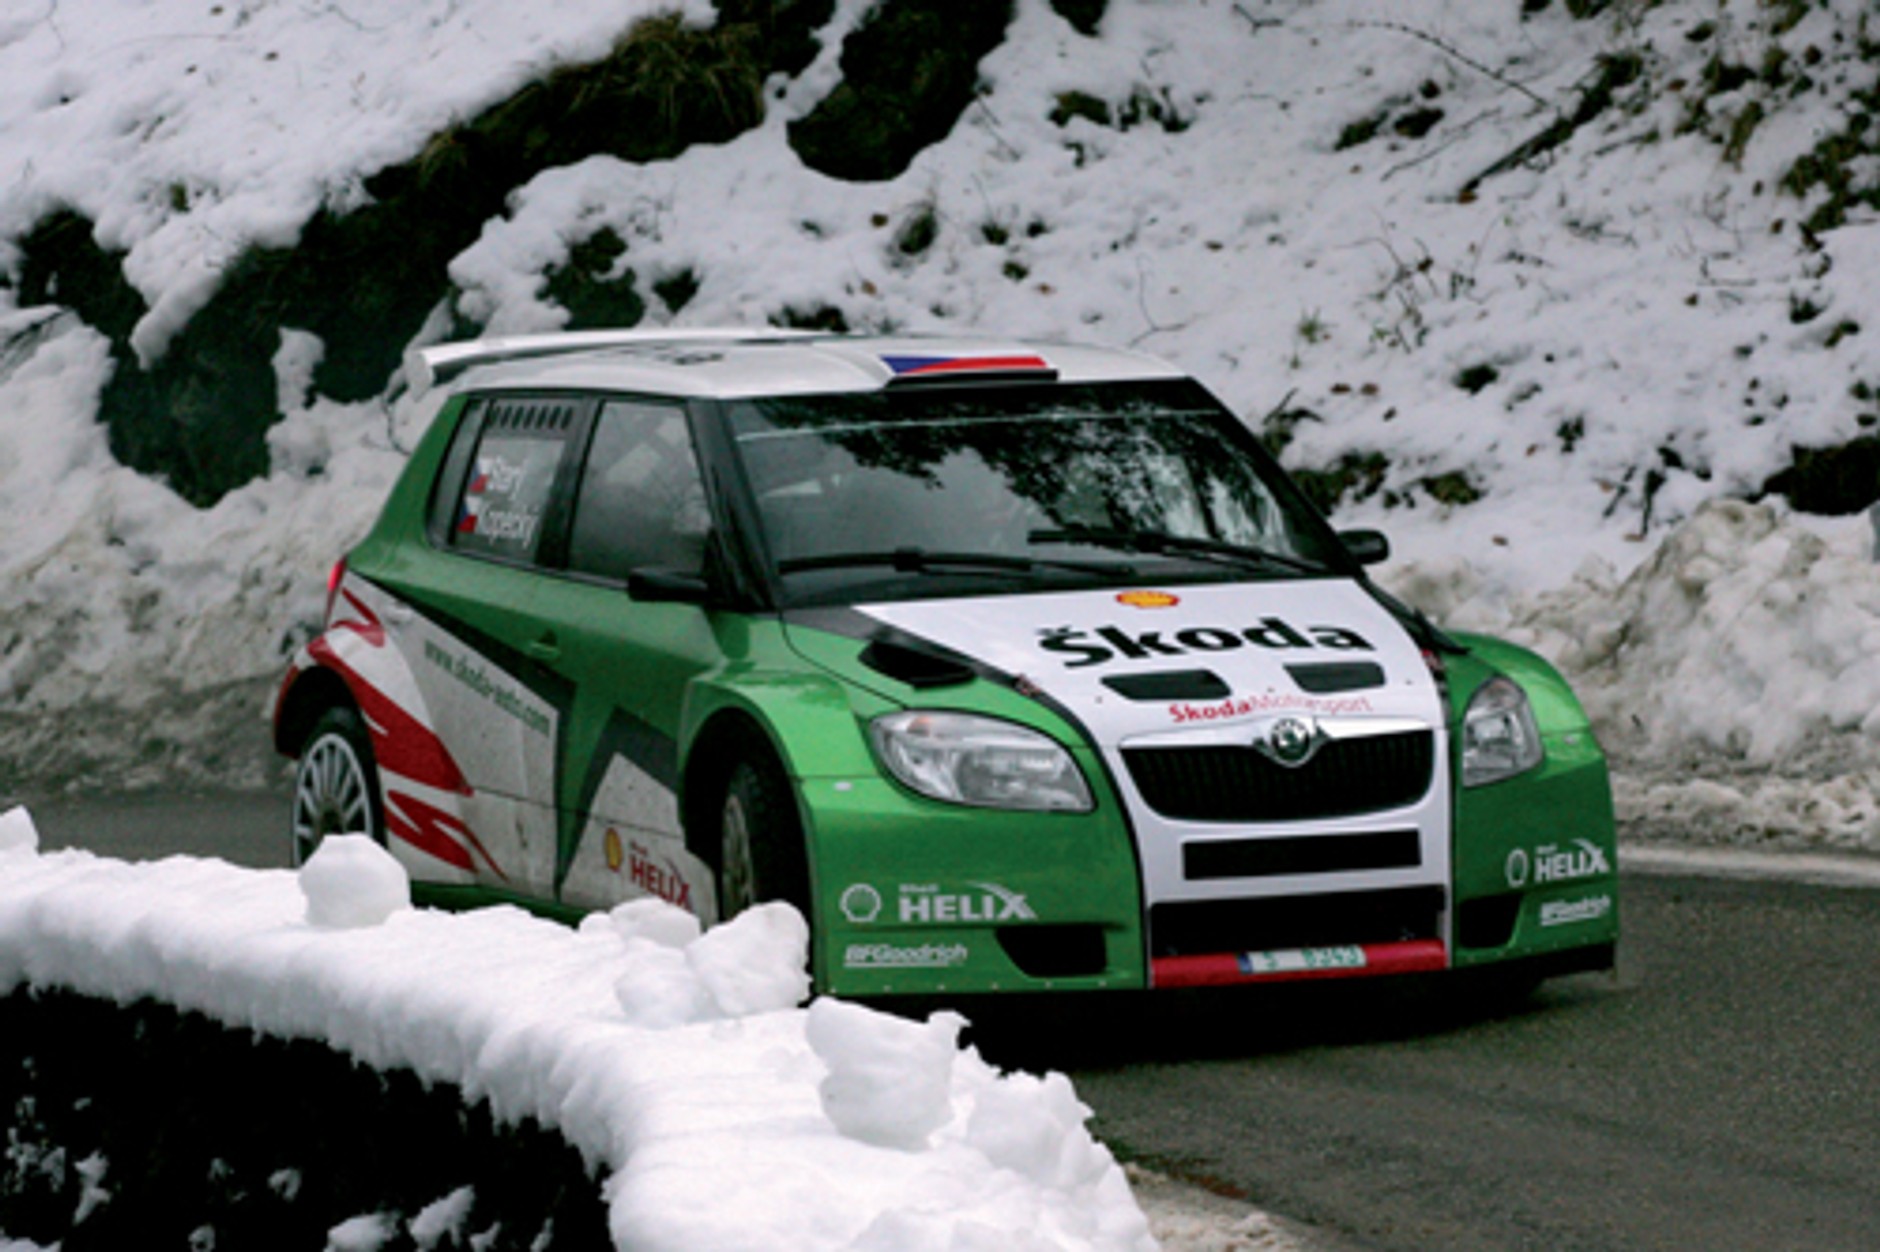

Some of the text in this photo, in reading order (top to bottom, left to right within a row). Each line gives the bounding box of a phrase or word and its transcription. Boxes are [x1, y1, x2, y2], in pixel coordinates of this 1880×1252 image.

[1036, 617, 1376, 668] Škoda
[1534, 839, 1609, 882] HELIX
[629, 855, 693, 914] HELIX
[899, 881, 1038, 922] HELIX
[844, 944, 968, 967] BFGoodrich
